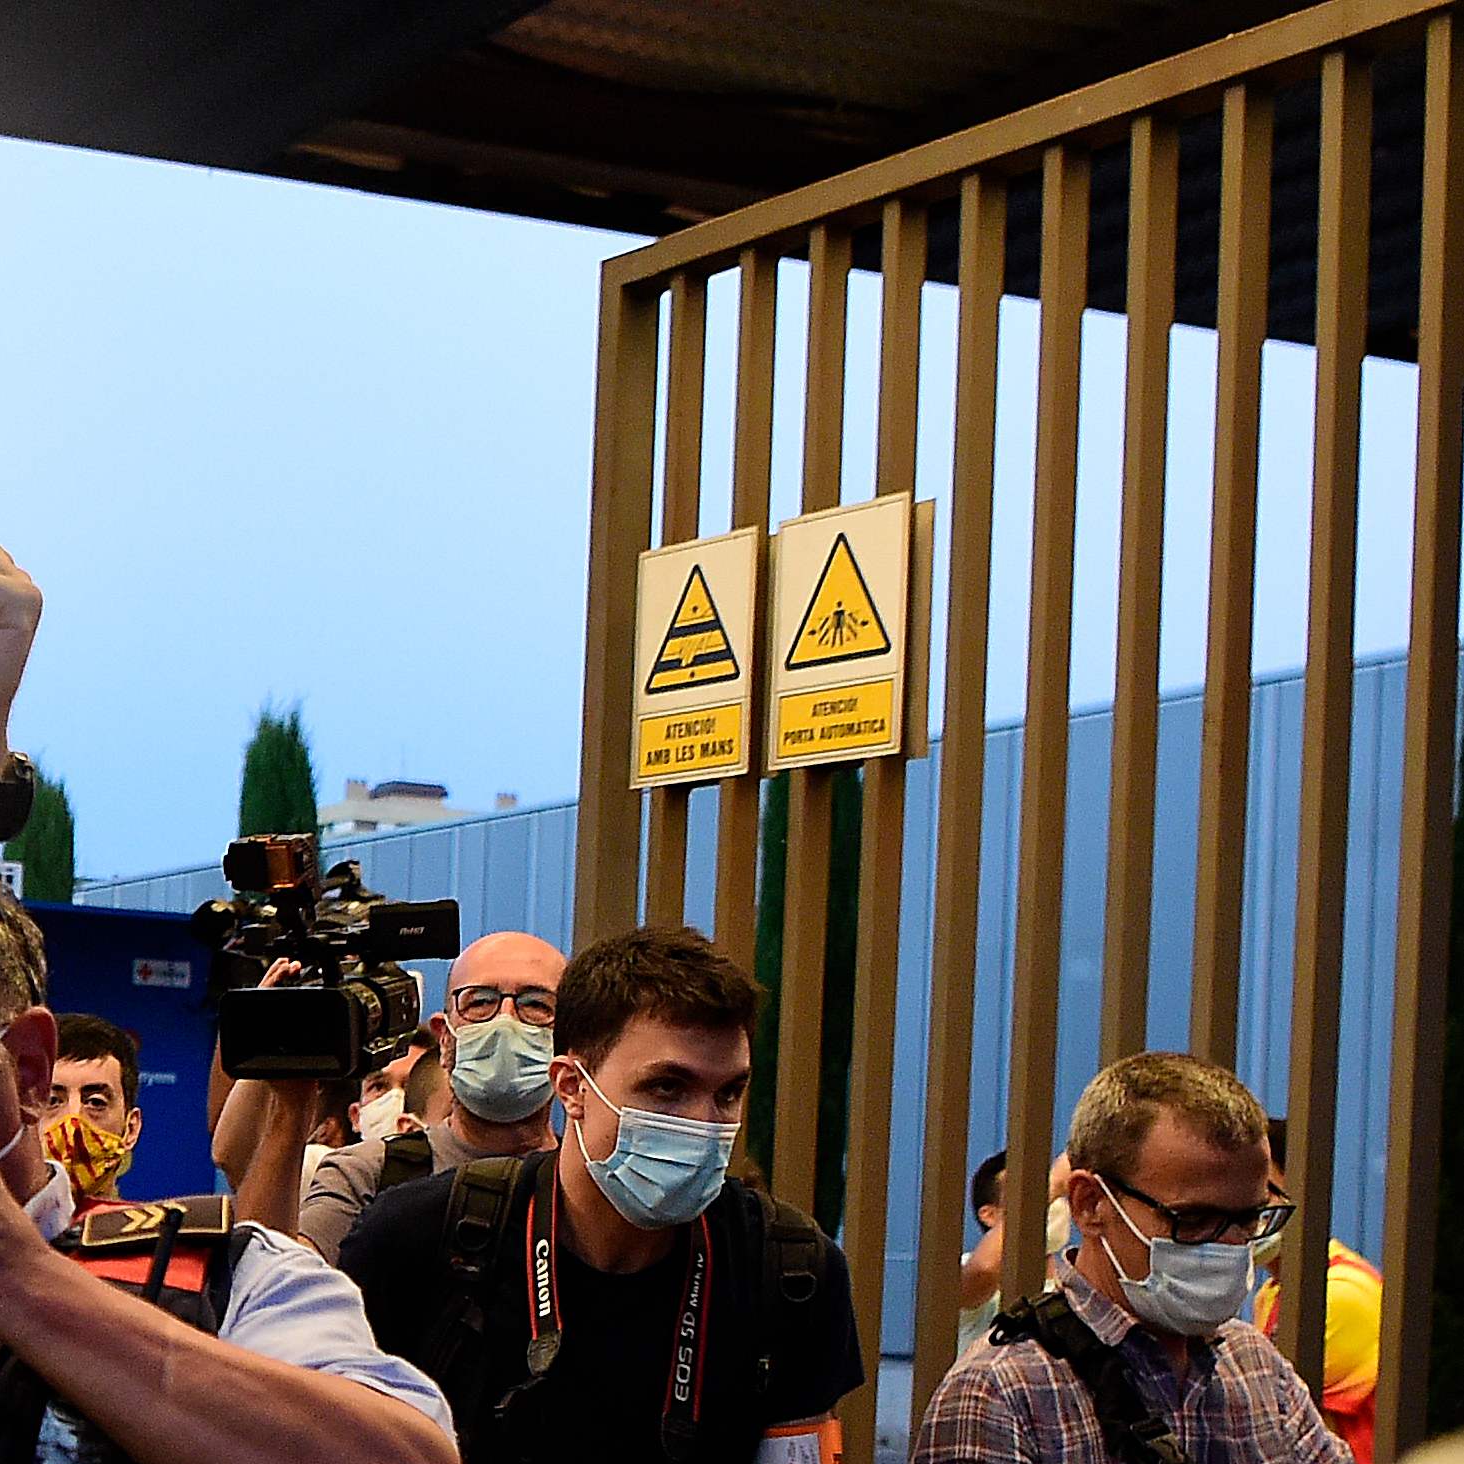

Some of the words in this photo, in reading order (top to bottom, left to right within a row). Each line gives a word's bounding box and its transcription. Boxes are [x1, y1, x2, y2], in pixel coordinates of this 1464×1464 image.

[646, 747, 671, 766] AMB
[675, 743, 696, 763] LES
[700, 738, 735, 759] MANS
[783, 727, 816, 746] PORTA
[535, 1238, 551, 1317] Canon
[689, 1271, 703, 1308] Mark
[680, 1311, 696, 1340] 5D
[674, 1345, 693, 1402] EOS
